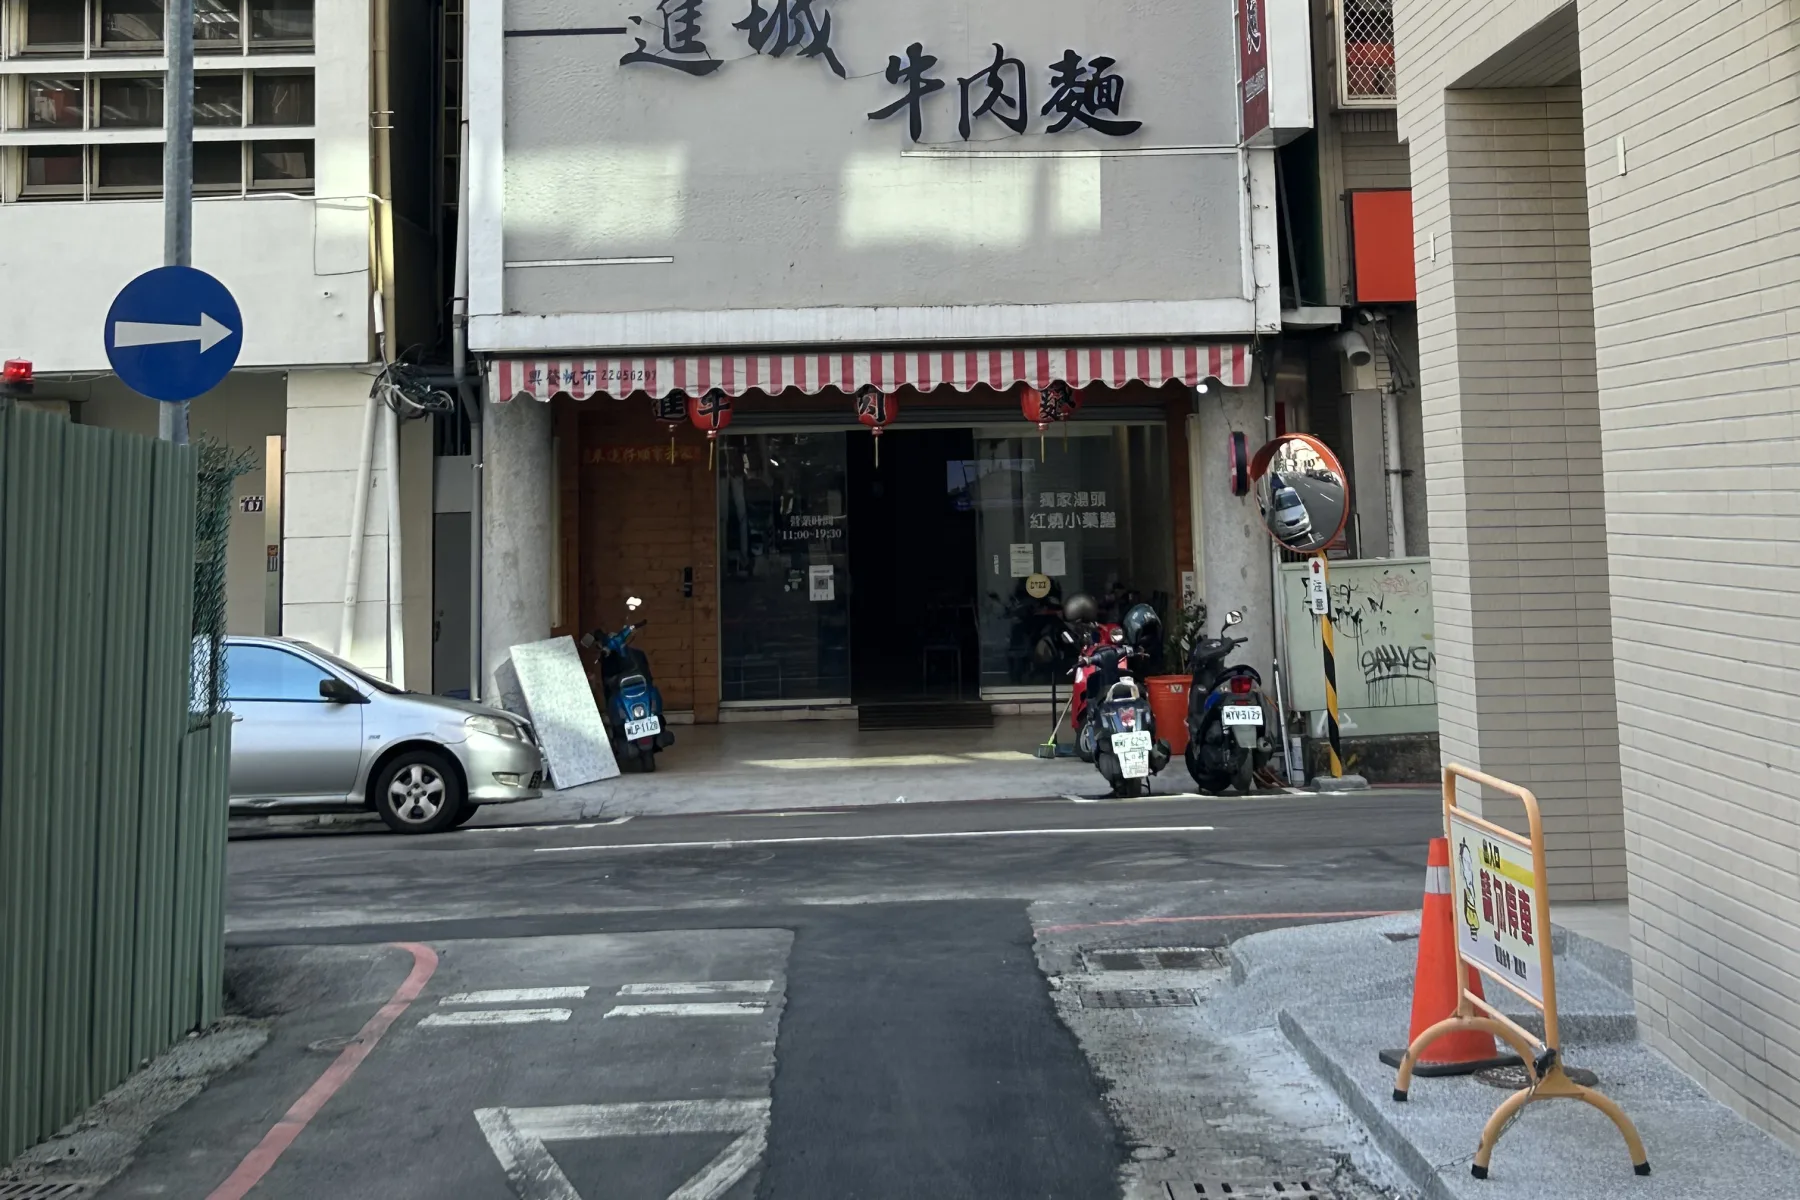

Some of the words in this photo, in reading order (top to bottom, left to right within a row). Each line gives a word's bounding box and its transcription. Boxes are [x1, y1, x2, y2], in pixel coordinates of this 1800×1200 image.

[867, 42, 1143, 142] 牛肉麵
[697, 388, 730, 428] 牛
[1040, 491, 1106, 507] 獨家湯頭
